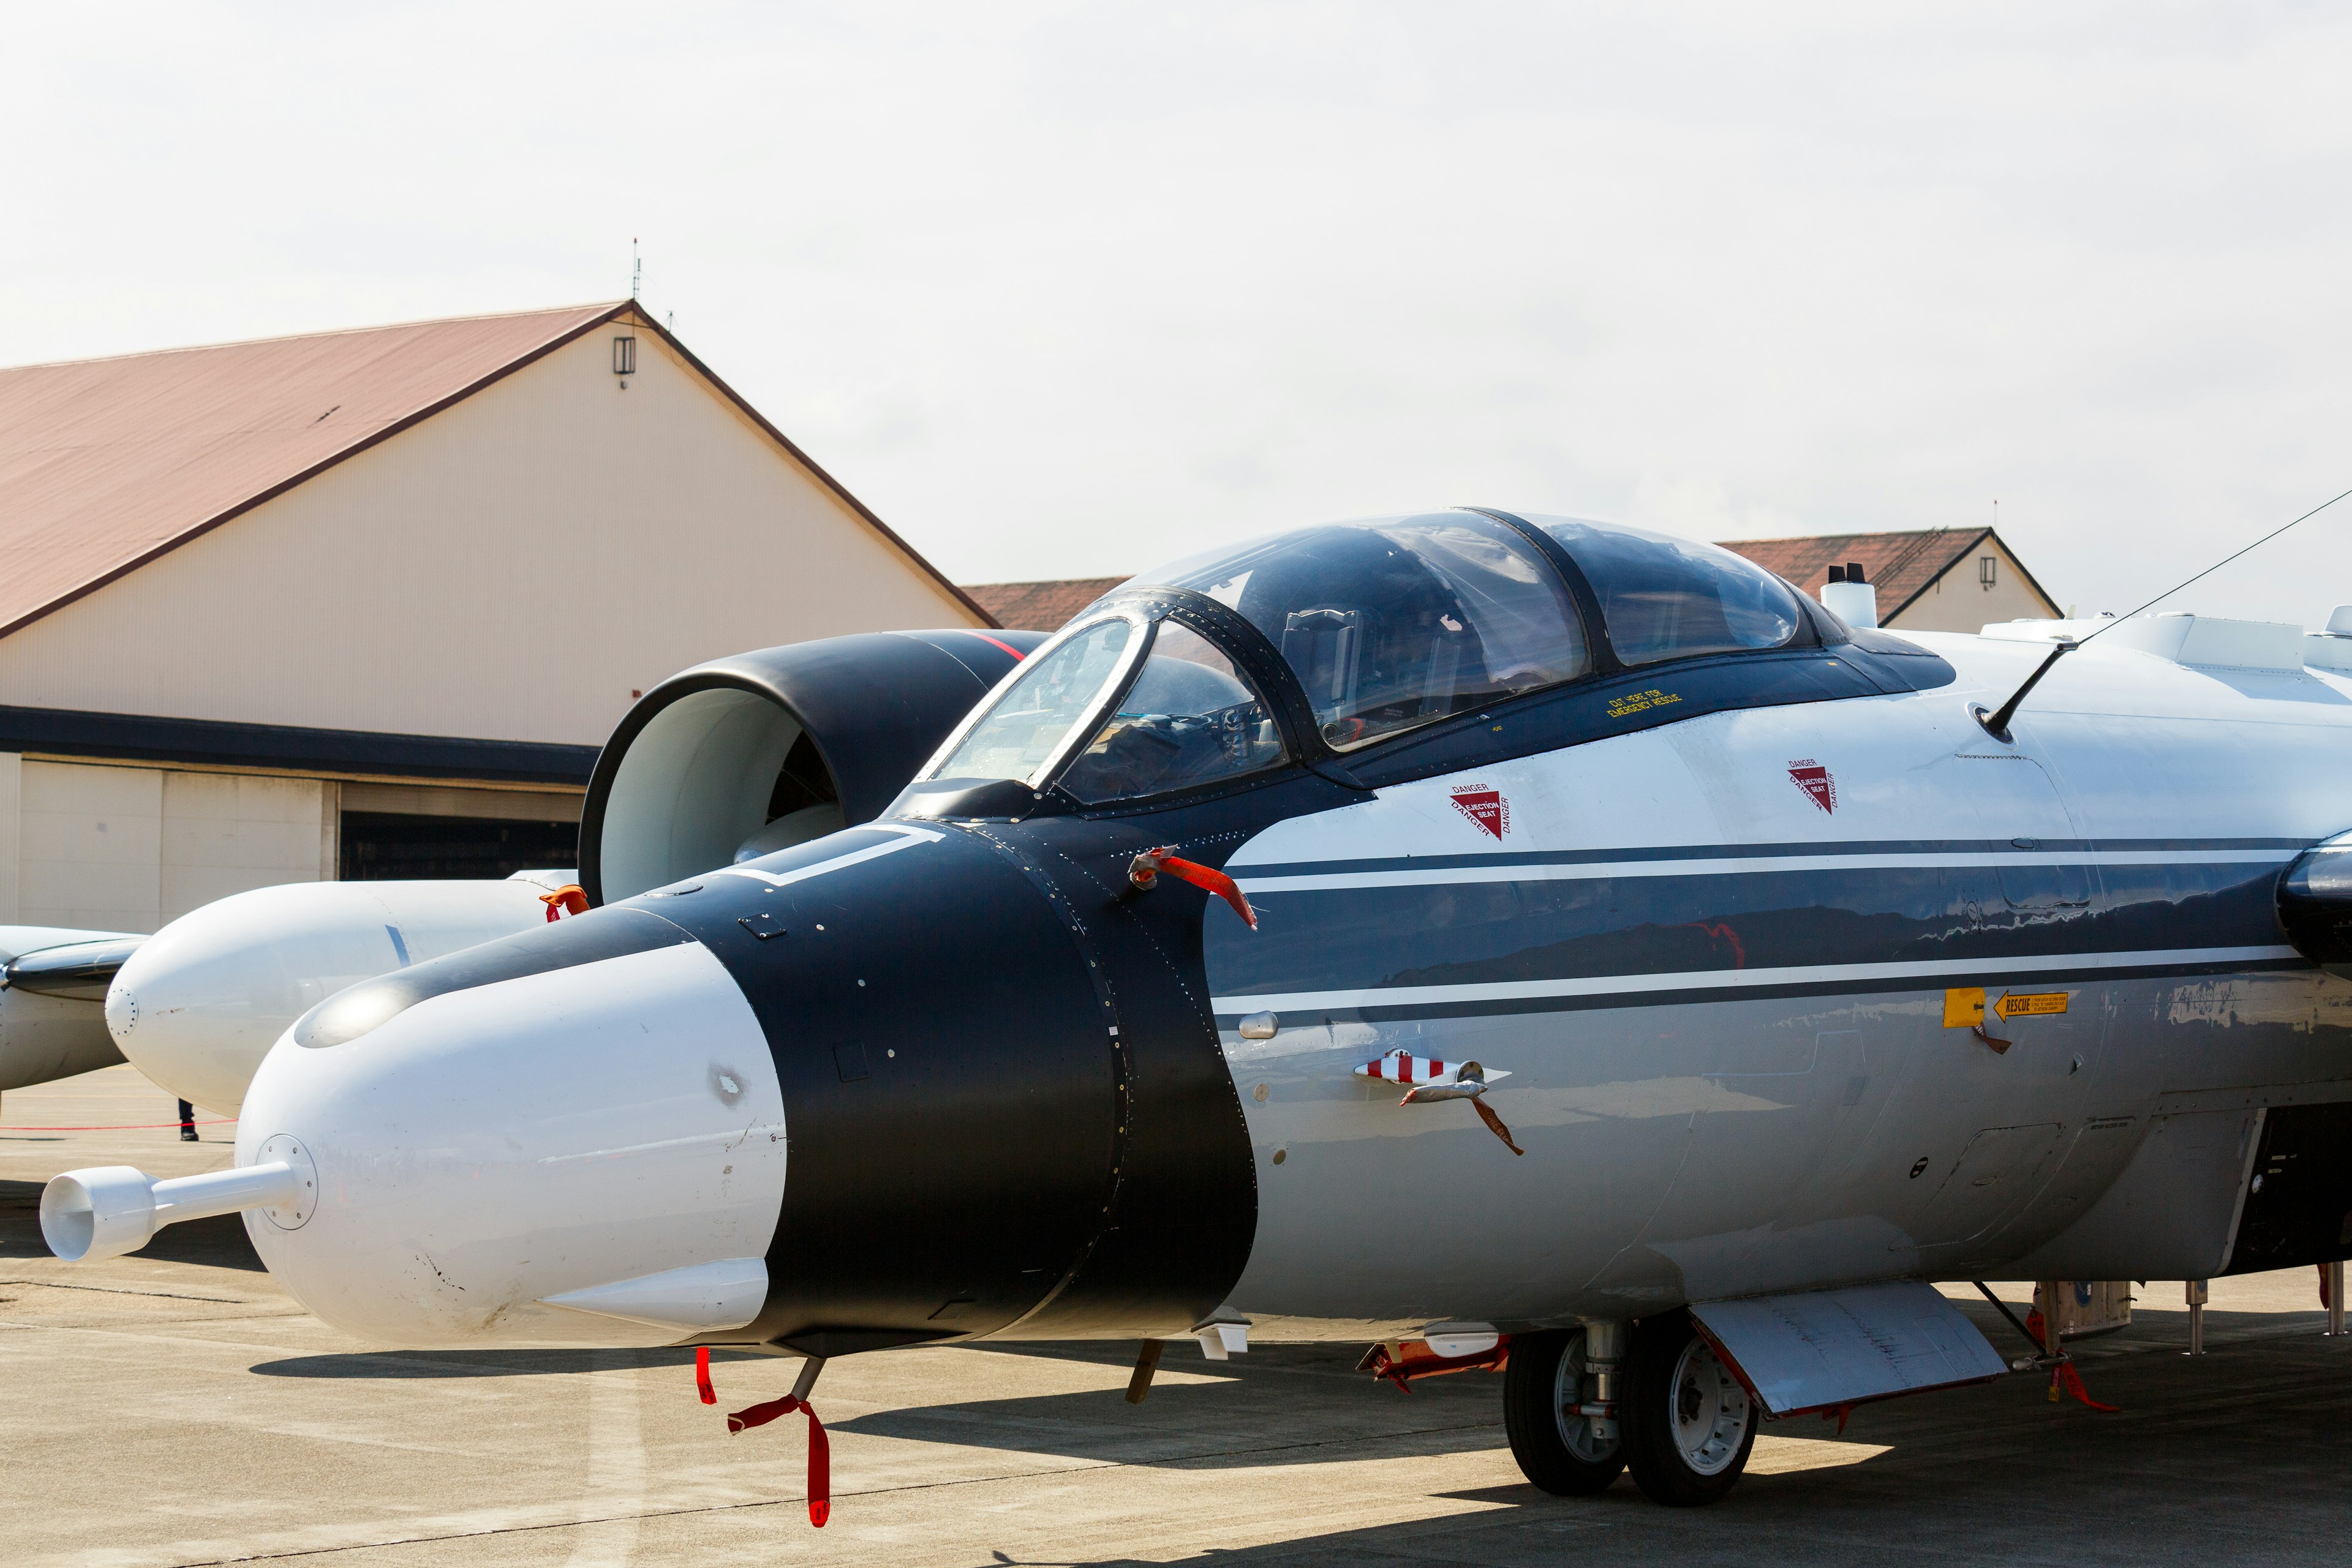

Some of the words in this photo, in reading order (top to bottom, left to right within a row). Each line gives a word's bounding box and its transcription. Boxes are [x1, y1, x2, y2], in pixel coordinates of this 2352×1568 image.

[1607, 701, 1653, 718] EMERGENCY
[1653, 693, 1683, 706] RESCUE
[1608, 698, 1626, 707] CUT
[1645, 689, 1664, 698] FOR
[1789, 759, 1817, 768] DANGER
[1452, 783, 1489, 794] DANGER
[1800, 777, 1827, 786] EJECTION
[1827, 772, 1838, 809] DANGER
[1790, 776, 1822, 811] DANGER
[1464, 801, 1499, 812] EJECTION
[1501, 797, 1510, 834] DANGER
[1450, 801, 1490, 837] DANGER
[2006, 998, 2030, 1012] RESCUE
